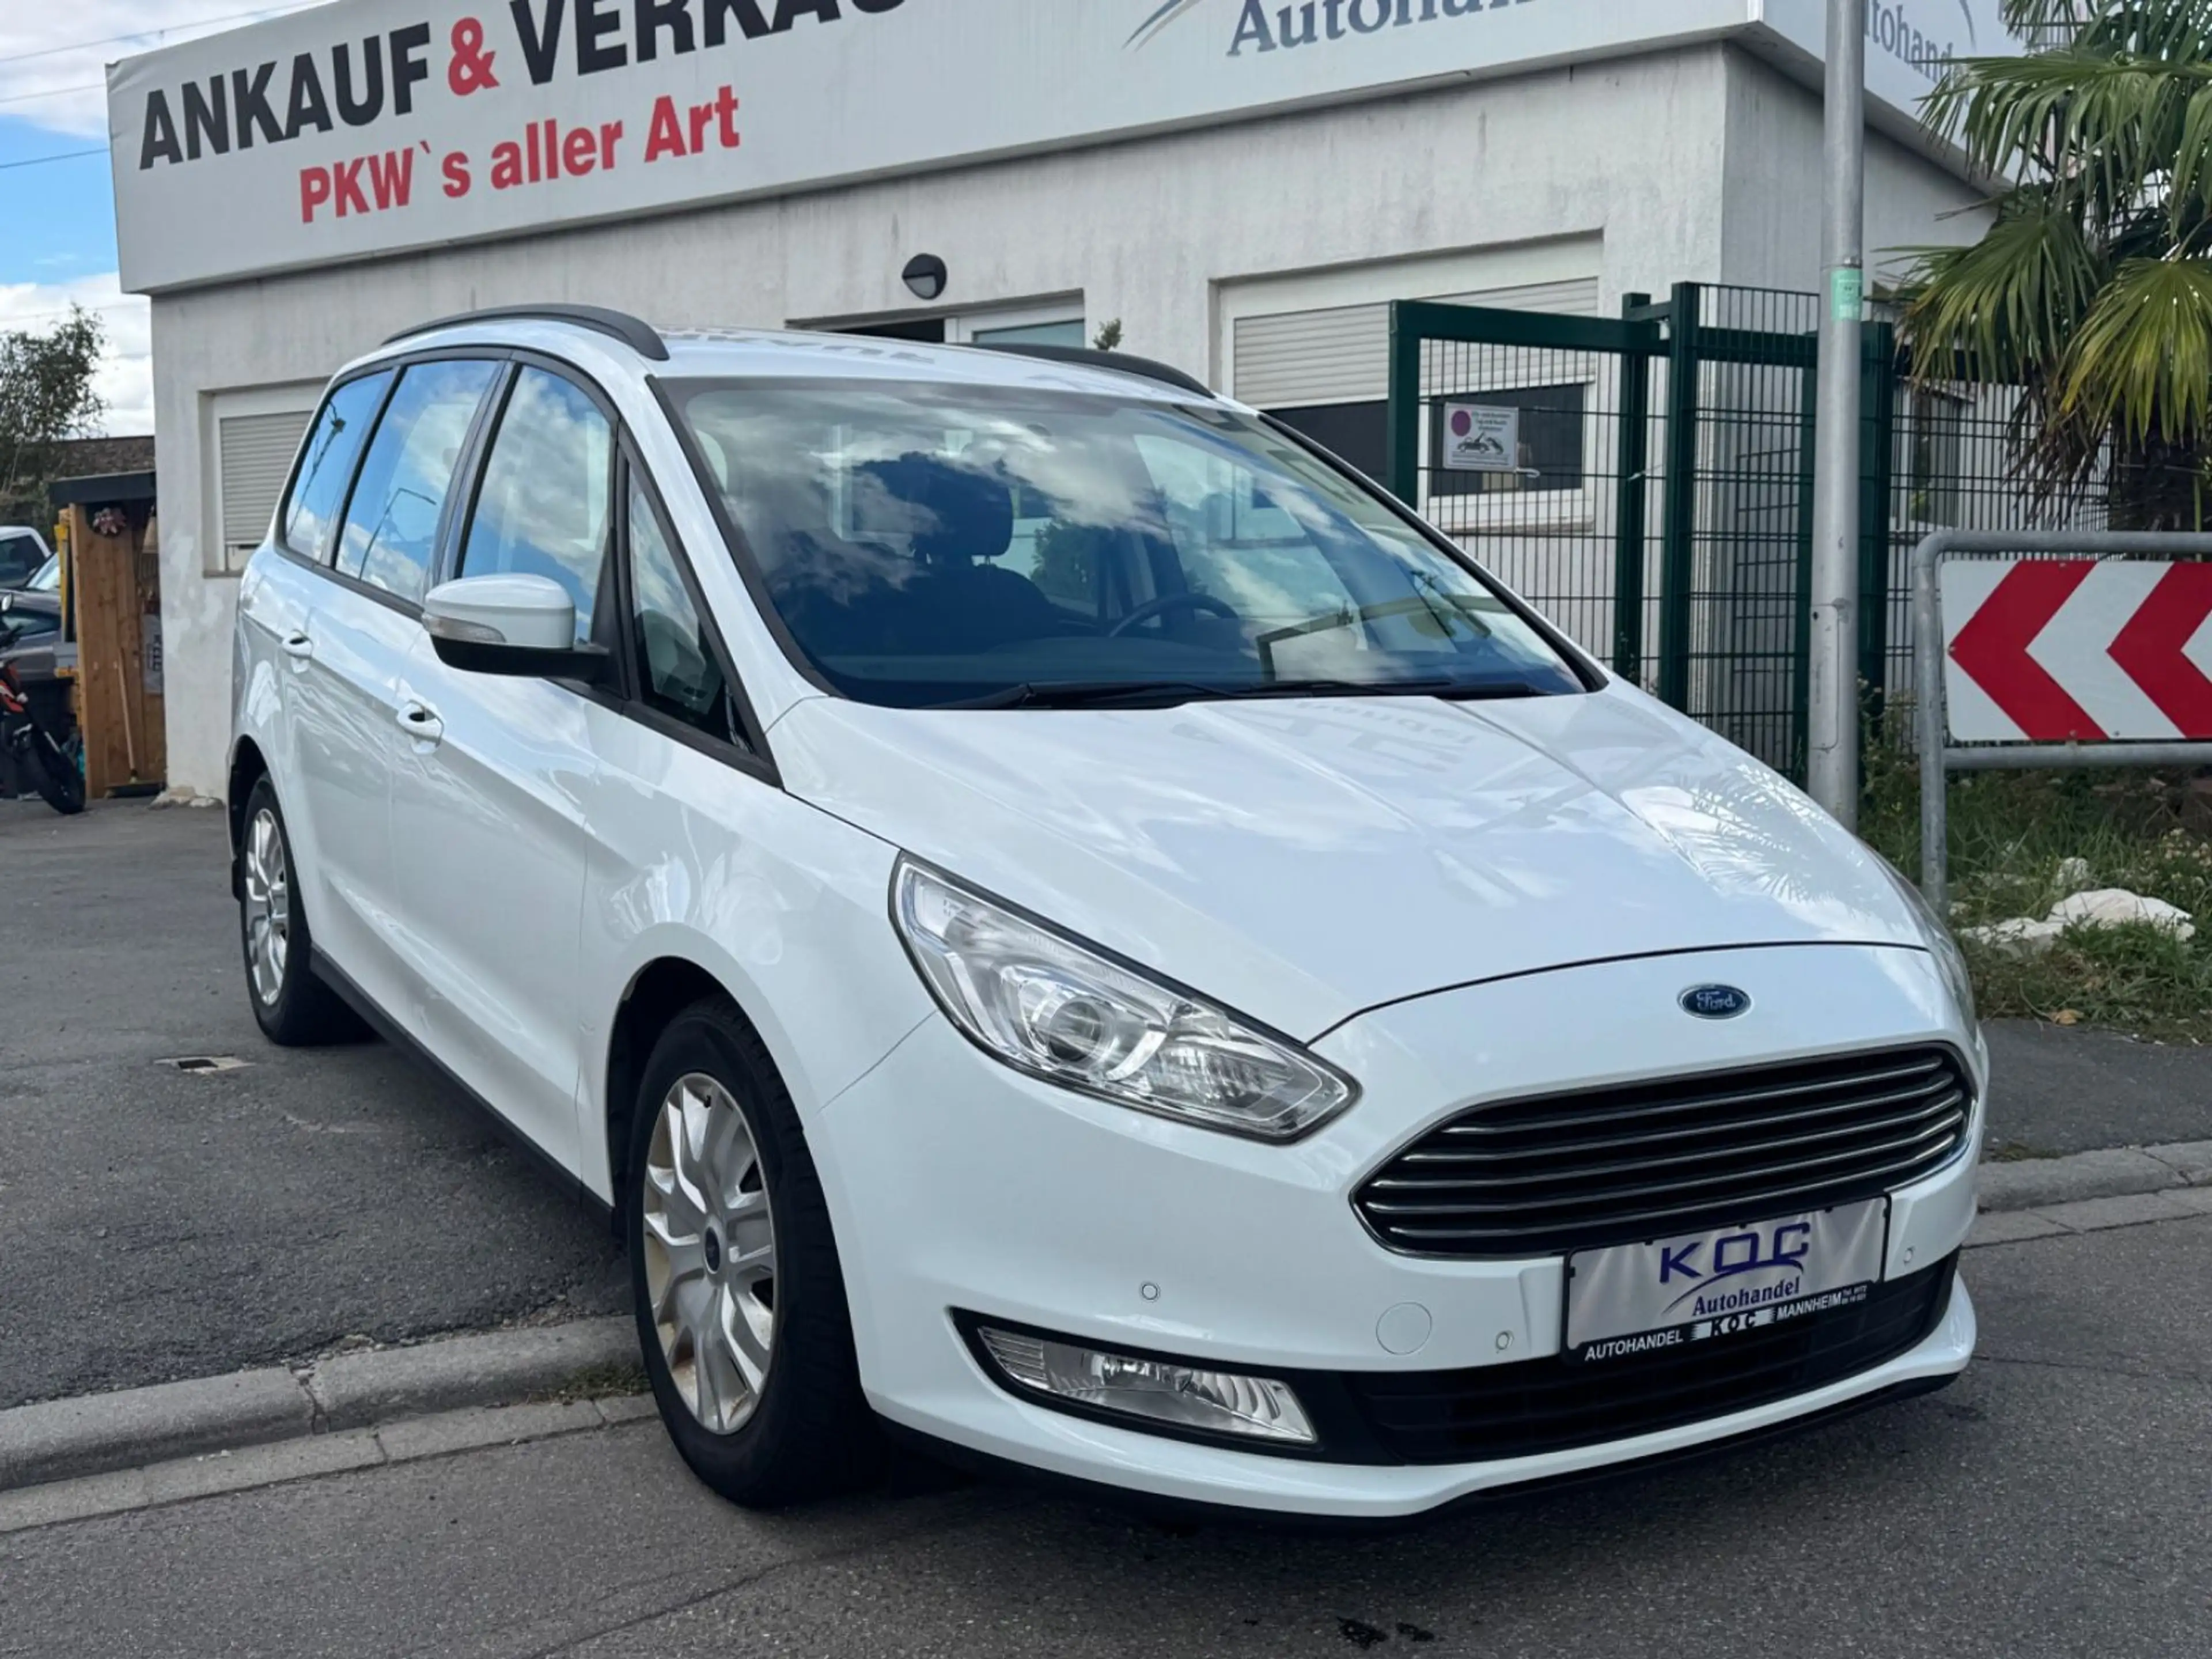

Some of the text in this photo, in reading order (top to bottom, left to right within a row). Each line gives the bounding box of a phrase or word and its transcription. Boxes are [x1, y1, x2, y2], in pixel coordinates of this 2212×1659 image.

[139, 0, 906, 170] ANKAUF & VERK
[491, 119, 623, 190] aller
[644, 85, 740, 163] Art
[1695, 990, 1736, 1011] Ford
[1585, 1329, 1683, 1361] AUTOHANDEL
[1776, 1291, 1842, 1321] MANNHEIM
[1692, 1276, 1800, 1316] Autohandel
